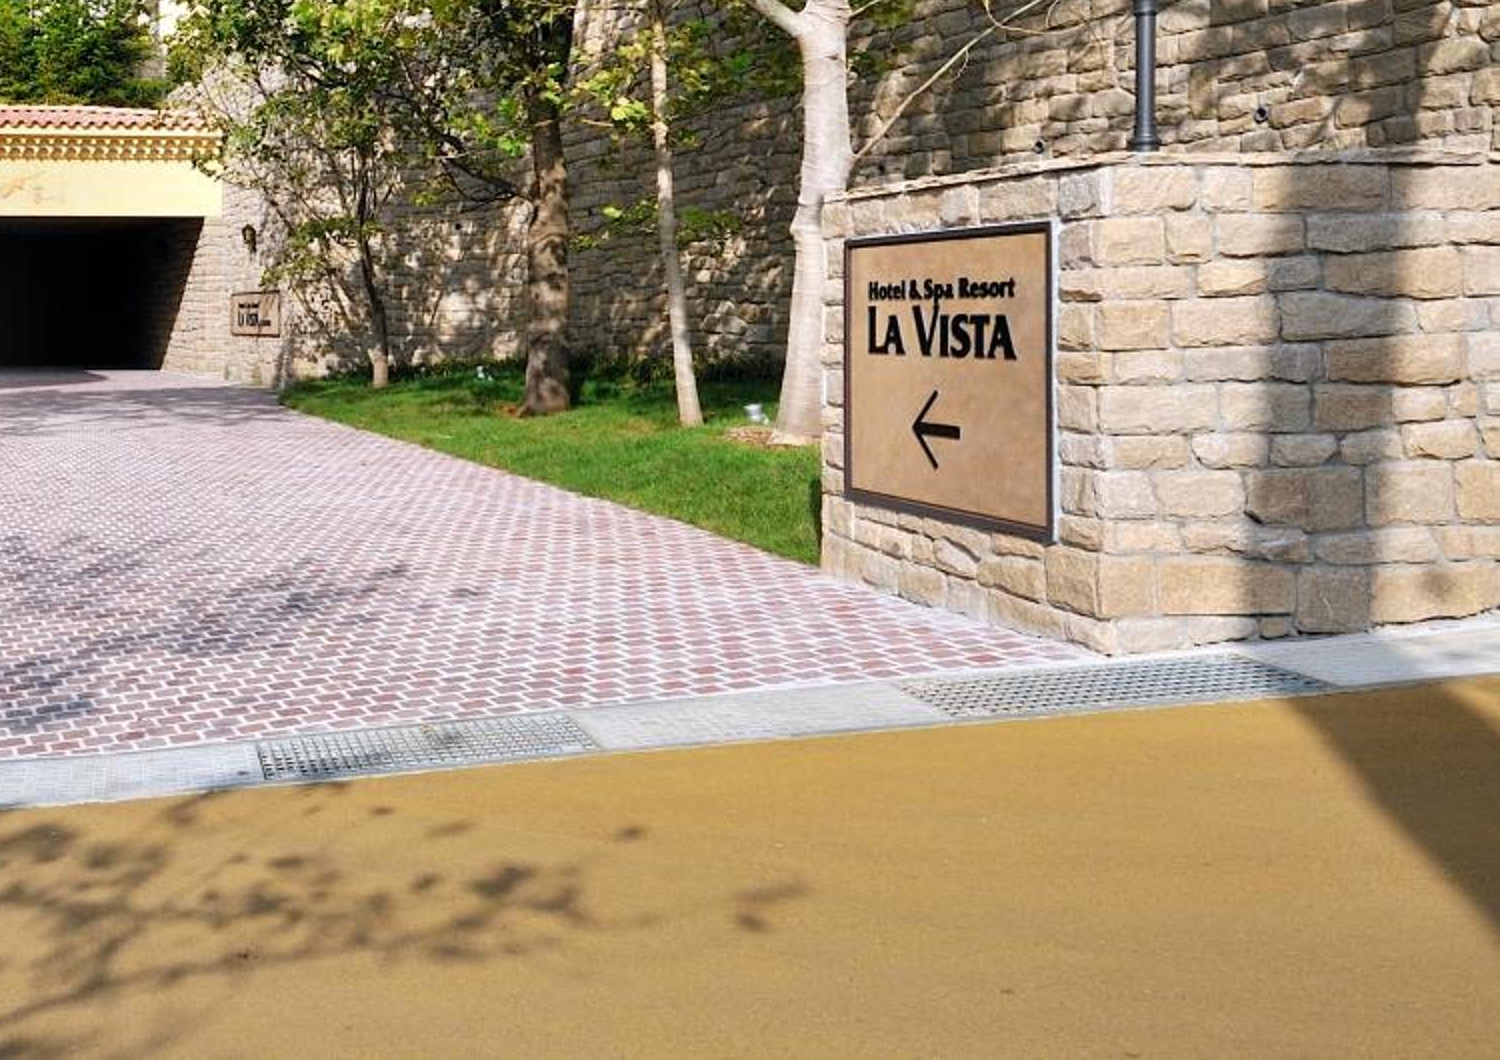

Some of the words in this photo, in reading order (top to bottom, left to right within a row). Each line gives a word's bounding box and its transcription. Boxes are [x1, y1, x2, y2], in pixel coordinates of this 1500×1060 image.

[868, 280, 906, 300] Hotel
[909, 279, 922, 300] &
[923, 278, 954, 304] Spa
[958, 277, 1015, 298] Resort
[868, 306, 906, 355] LA
[912, 304, 1017, 360] VISTA
